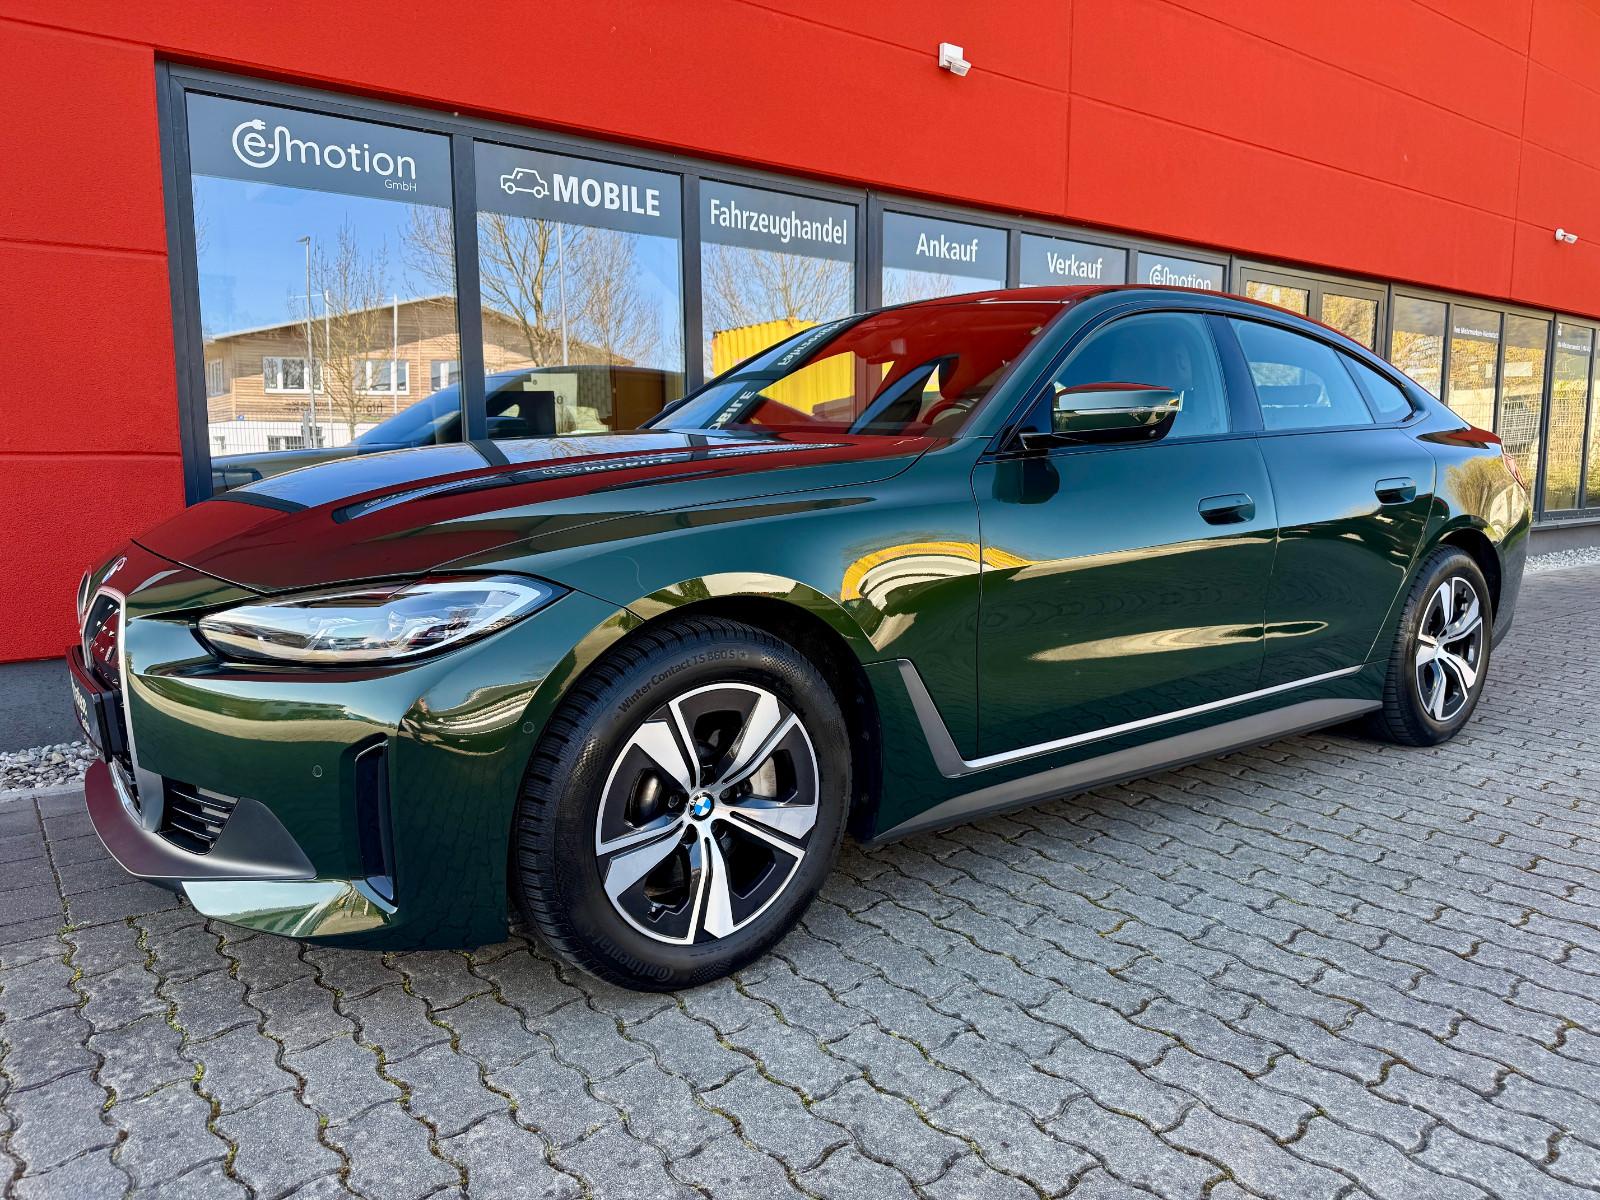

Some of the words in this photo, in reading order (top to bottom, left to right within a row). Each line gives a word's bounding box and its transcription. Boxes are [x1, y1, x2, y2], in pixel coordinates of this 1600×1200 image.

[384, 179, 417, 192] GmbH
[552, 173, 660, 217] MOBILE
[710, 199, 847, 246] Fahrzeughandel
[916, 233, 978, 263] Ankauf
[1047, 251, 1103, 280] Verkauf
